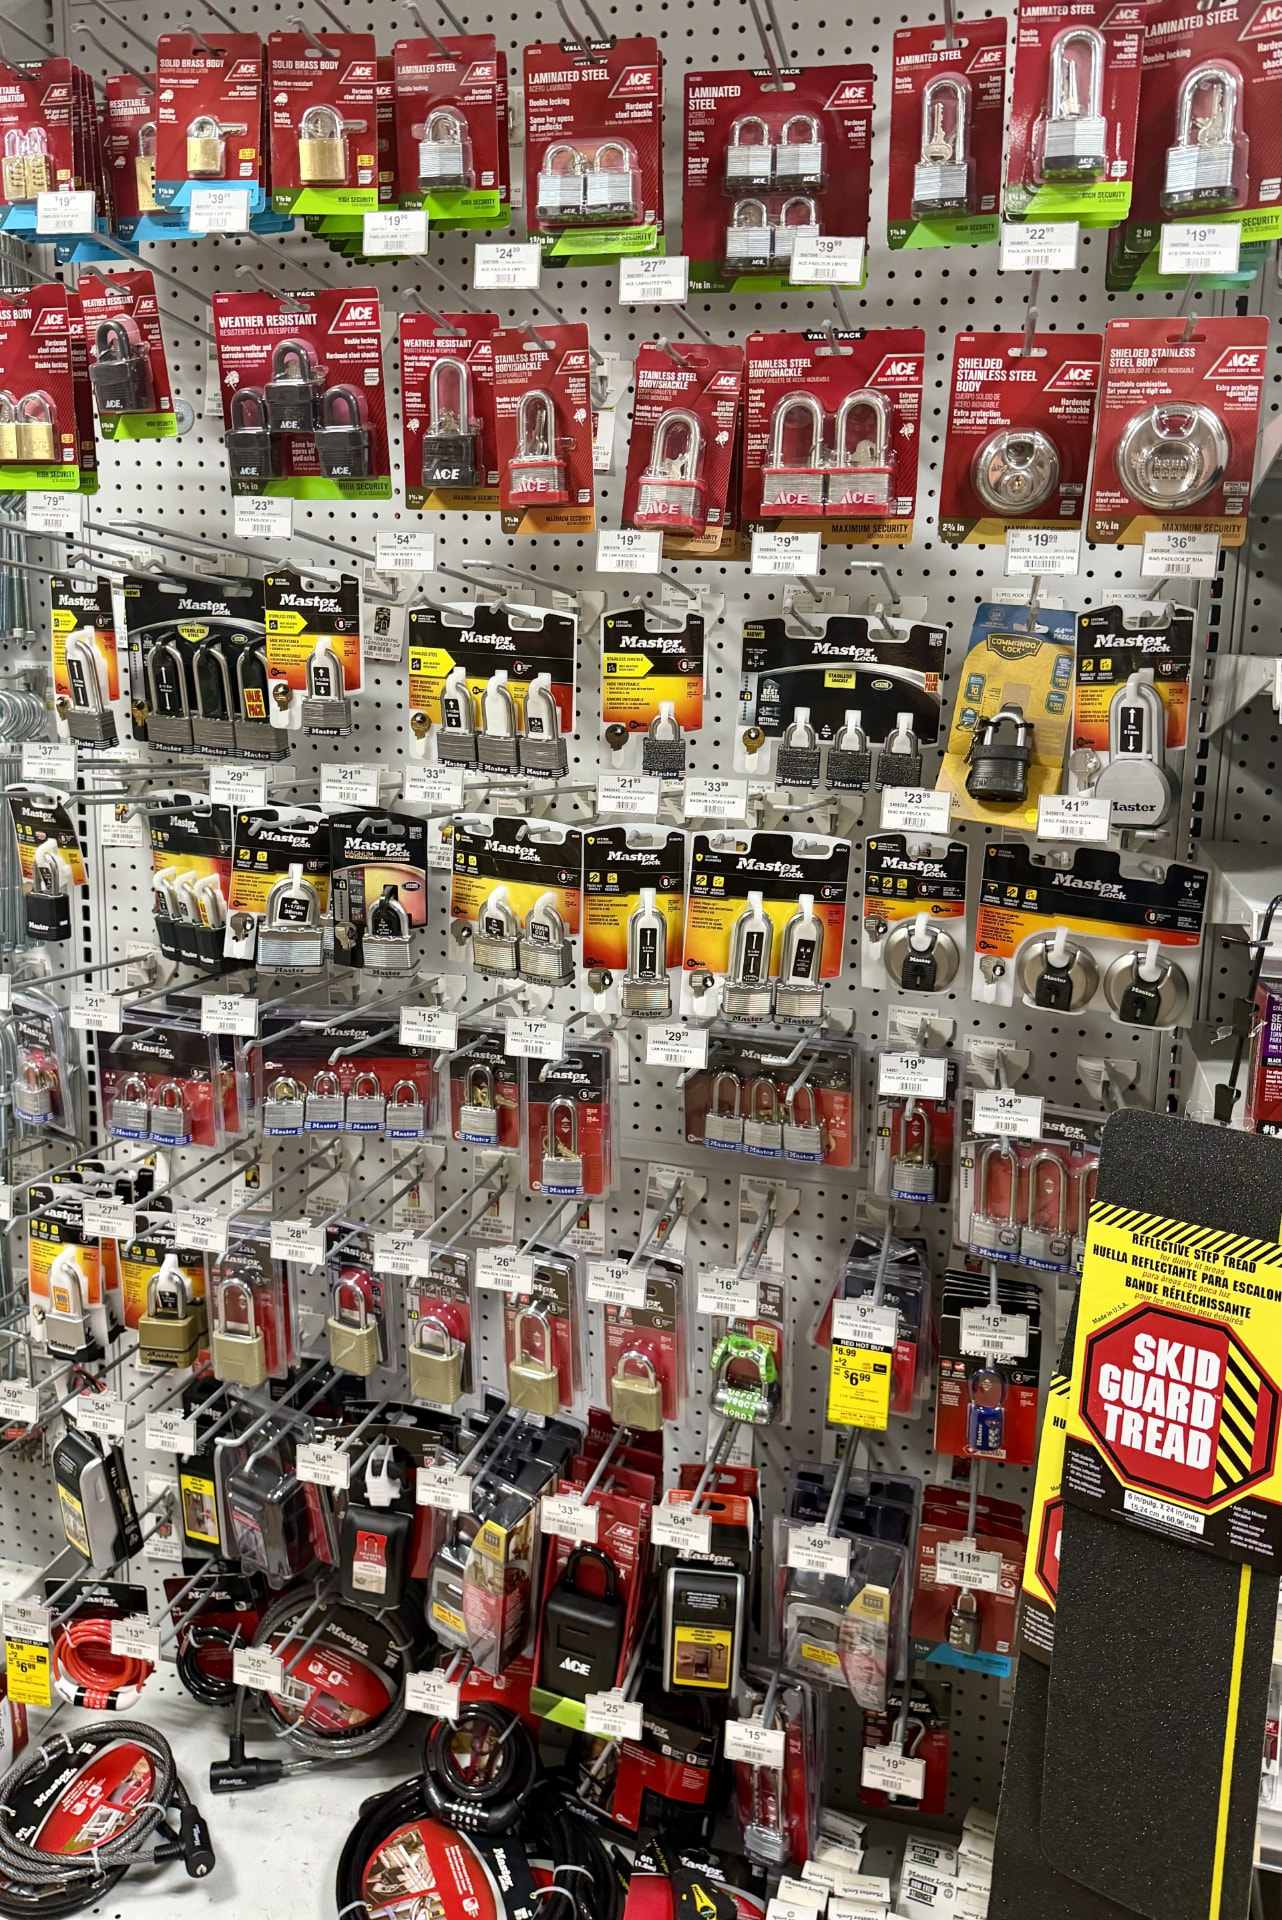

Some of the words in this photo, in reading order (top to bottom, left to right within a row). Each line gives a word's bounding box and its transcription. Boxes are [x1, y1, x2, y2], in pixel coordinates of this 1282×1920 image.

[1022, 6, 1070, 17] LAMINATED
[1070, 4, 1096, 16] STEEL
[1114, 8, 1140, 20] ACE
[1144, 14, 1204, 38] LAMINATED
[1206, 8, 1240, 26] STEEL
[896, 52, 938, 66] LAMINATED
[940, 50, 962, 62] STEEL
[980, 52, 1002, 62] ACE
[1142, 54, 1165, 64] Double
[1166, 48, 1192, 61] locking
[160, 59, 180, 68] SOLID
[182, 58, 202, 68] BRASS
[202, 58, 224, 68] BODY
[398, 64, 436, 74] LAMINATED
[436, 62, 456, 73] STEEL
[472, 66, 492, 76] ACE
[528, 71, 580, 84] LAMINATED
[582, 68, 610, 81] STEEL
[626, 72, 652, 86] ACE
[688, 86, 741, 98] LAMINATED
[840, 86, 866, 98] ACE
[688, 98, 716, 110] STEEL
[1096, 190, 1126, 199] SECURITY
[1242, 215, 1280, 228] SECURITY
[622, 232, 652, 241] SECURITY
[346, 306, 374, 320] ACE
[44, 314, 64, 325] ACE
[218, 316, 264, 328] WEATHER
[266, 314, 318, 326] RESISTANT
[838, 332, 860, 340] PACK
[404, 340, 435, 348] WEATHER
[436, 339, 472, 348] RESISTANT
[494, 354, 528, 364] STAINLESS
[530, 352, 550, 362] STEEL
[1110, 348, 1149, 358] SHIELDED
[1150, 348, 1196, 358] STAINLESS
[566, 355, 585, 365] ACE
[748, 359, 788, 369] STAINLESS
[790, 358, 812, 368] STEEL
[958, 358, 1003, 370] SHIELDED
[1109, 358, 1134, 368] STEEL
[1136, 358, 1159, 368] BODY
[1226, 353, 1260, 367] ACE
[495, 362, 542, 372] BODY/SHACKLE
[748, 368, 802, 378] BODY/SHACKLE
[884, 361, 918, 376] ACE
[639, 370, 676, 381] STAINLESS
[676, 372, 698, 382] STEEL
[956, 370, 1007, 382] STAINLESS
[1008, 370, 1038, 382] STEEL
[1063, 368, 1094, 381] ACE
[638, 380, 688, 390] BODY/SHACKLE
[716, 376, 736, 386] ACE
[956, 380, 981, 392] BODY
[1060, 398, 1091, 406] Hardened
[953, 409, 969, 418] Extra
[970, 410, 1001, 418] protection
[1048, 405, 1064, 414] steel
[1066, 406, 1090, 414] shackle
[952, 416, 976, 426] against
[432, 468, 460, 480] ACE
[774, 490, 809, 505] ACE
[840, 489, 875, 504] ACE
[646, 500, 680, 514] ACE
[832, 524, 870, 534] MAXIMUM
[872, 524, 908, 534] SECURITY
[1162, 523, 1202, 533] MAXIMUM
[1204, 524, 1242, 534] SECURITY
[58, 594, 96, 607] Master
[178, 598, 226, 612] Master
[279, 593, 338, 608] Master
[211, 608, 232, 616] Lock
[318, 602, 343, 614] Lock
[460, 630, 512, 646] Master
[620, 636, 682, 650] Master
[992, 637, 1036, 650] COMMANDO
[1094, 634, 1166, 650] Master
[494, 642, 516, 652] Lock
[662, 644, 686, 654] Lock
[812, 642, 874, 656] Master
[1002, 646, 1023, 654] LOCK
[1140, 643, 1171, 654] Lock
[853, 653, 878, 662] Lock
[258, 830, 308, 844] Master
[292, 840, 311, 848] Lock
[344, 838, 406, 852] Master
[484, 840, 536, 856] Master
[385, 848, 410, 858] Lock
[519, 851, 541, 862] Lock
[606, 851, 658, 862] Master
[640, 857, 661, 866] Lock
[736, 858, 800, 873] Master
[880, 856, 944, 872] Master
[778, 869, 804, 878] Lock
[922, 868, 948, 878] Lock
[1052, 872, 1124, 893] Master
[1098, 890, 1126, 901] Lock
[132, 1041, 172, 1056] Master
[708, 1140, 735, 1150] Master
[549, 1186, 576, 1195] Master
[900, 1191, 926, 1202] Master
[1132, 1233, 1190, 1258] REFLECTIVE
[1194, 1248, 1220, 1265] STEP
[1223, 1254, 1256, 1274] TREAD
[1092, 1244, 1128, 1264] HUELLA
[1132, 1254, 1198, 1282] REFLECTANTE
[1201, 1273, 1229, 1290] PARA
[1160, 1252, 1172, 1261] for
[1172, 1255, 1193, 1268] dimly
[1194, 1260, 1203, 1269] lit
[1203, 1264, 1226, 1276] areas
[1142, 1270, 1160, 1282] para
[1160, 1272, 1182, 1287] áreas
[1182, 1280, 1198, 1291] con
[1198, 1284, 1218, 1298] poca
[1218, 1288, 1232, 1299] luz
[1125, 1276, 1159, 1296] BANDE
[1162, 1285, 1252, 1319] RÉFLÉCHISSANTE
[1092, 1312, 1107, 1326] Made
[1107, 1308, 1114, 1316] in
[1112, 1301, 1130, 1314] U.S.A.
[1134, 1292, 1152, 1304] pour
[1152, 1294, 1164, 1305] les
[1165, 1298, 1197, 1315] endroits
[1198, 1307, 1213, 1320] peu
[1213, 1308, 1244, 1326] éclairés
[840, 1339, 855, 1348] RED
[855, 1340, 869, 1350] HOT
[870, 1342, 885, 1352] BUY
[1132, 1332, 1221, 1390] SKID
[1098, 1362, 1217, 1430] GUARD
[1103, 1402, 1212, 1470] TREAD
[1166, 1504, 1174, 1514] 24
[560, 1656, 591, 1676] ACE
